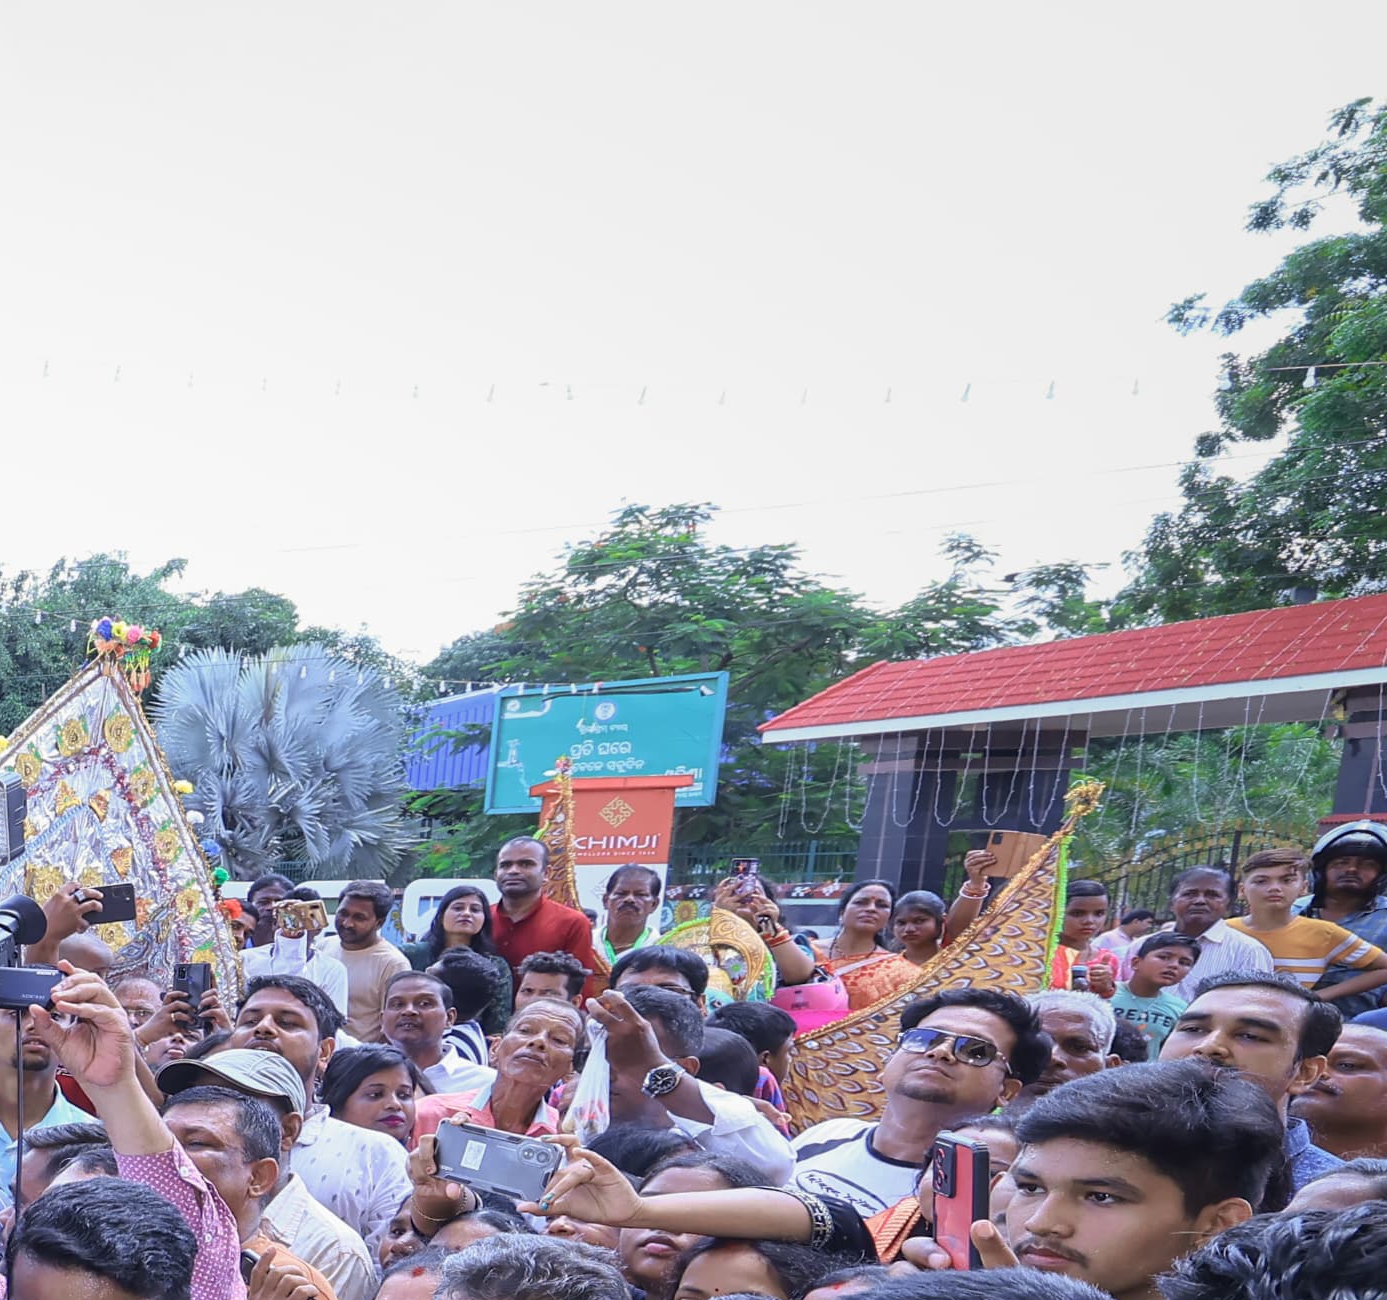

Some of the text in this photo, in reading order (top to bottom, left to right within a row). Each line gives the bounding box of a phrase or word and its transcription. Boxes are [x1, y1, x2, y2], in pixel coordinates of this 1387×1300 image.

[570, 740, 632, 759] ପ୍ରତି ଘରେ
[1114, 1007, 1173, 1027] REATE
